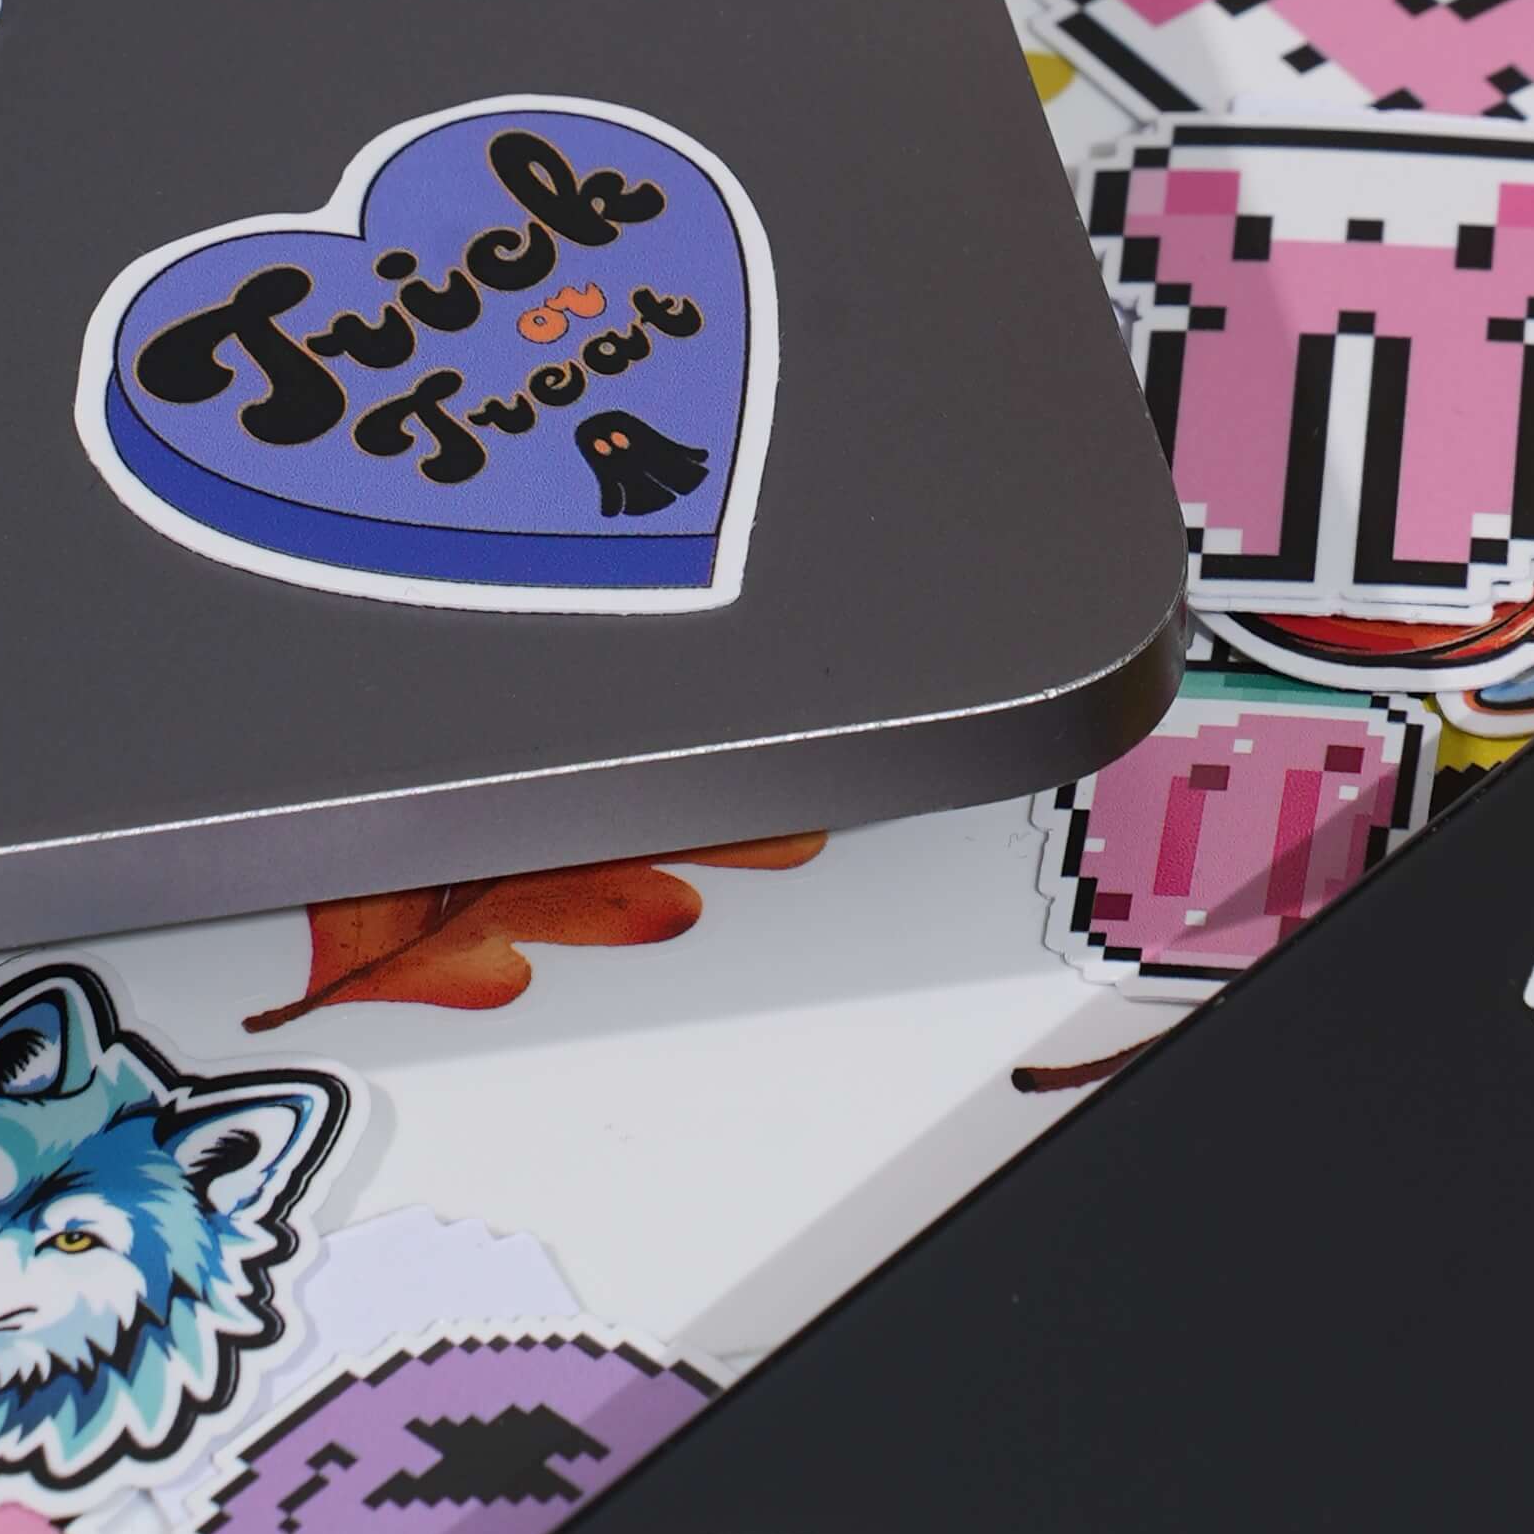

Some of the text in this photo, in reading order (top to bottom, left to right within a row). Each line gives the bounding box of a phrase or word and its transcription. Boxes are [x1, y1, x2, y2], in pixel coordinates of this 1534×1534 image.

[134, 127, 667, 447] Trick
[351, 287, 704, 485] Treat
[516, 281, 608, 345] or
